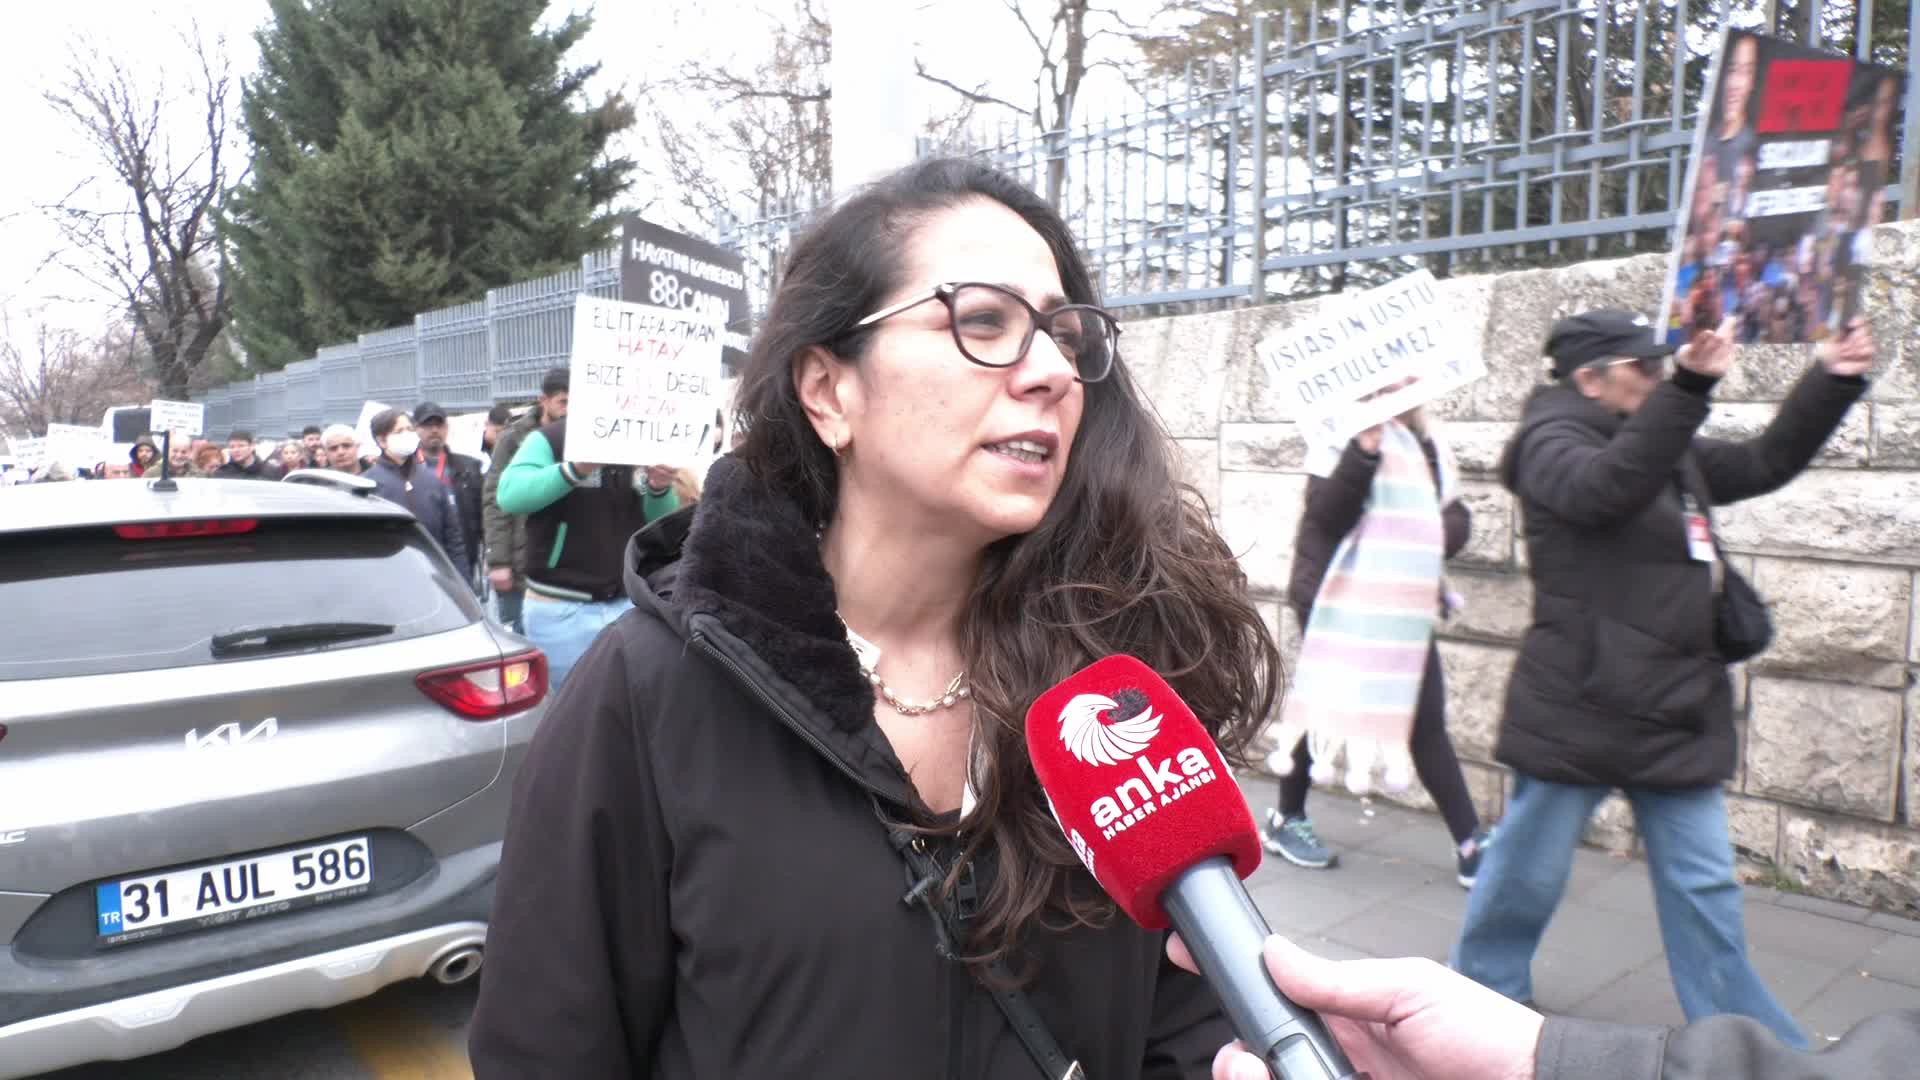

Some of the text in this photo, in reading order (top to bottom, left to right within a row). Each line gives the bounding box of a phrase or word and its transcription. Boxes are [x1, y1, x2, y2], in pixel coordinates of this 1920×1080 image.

[650, 270, 680, 309] 88
[617, 336, 687, 361] HATAY
[1090, 747, 1211, 828] anka
[1102, 769, 1217, 841] HABER AJANSI
[122, 843, 366, 923] 31 AUL 586
[101, 911, 121, 925] TR
